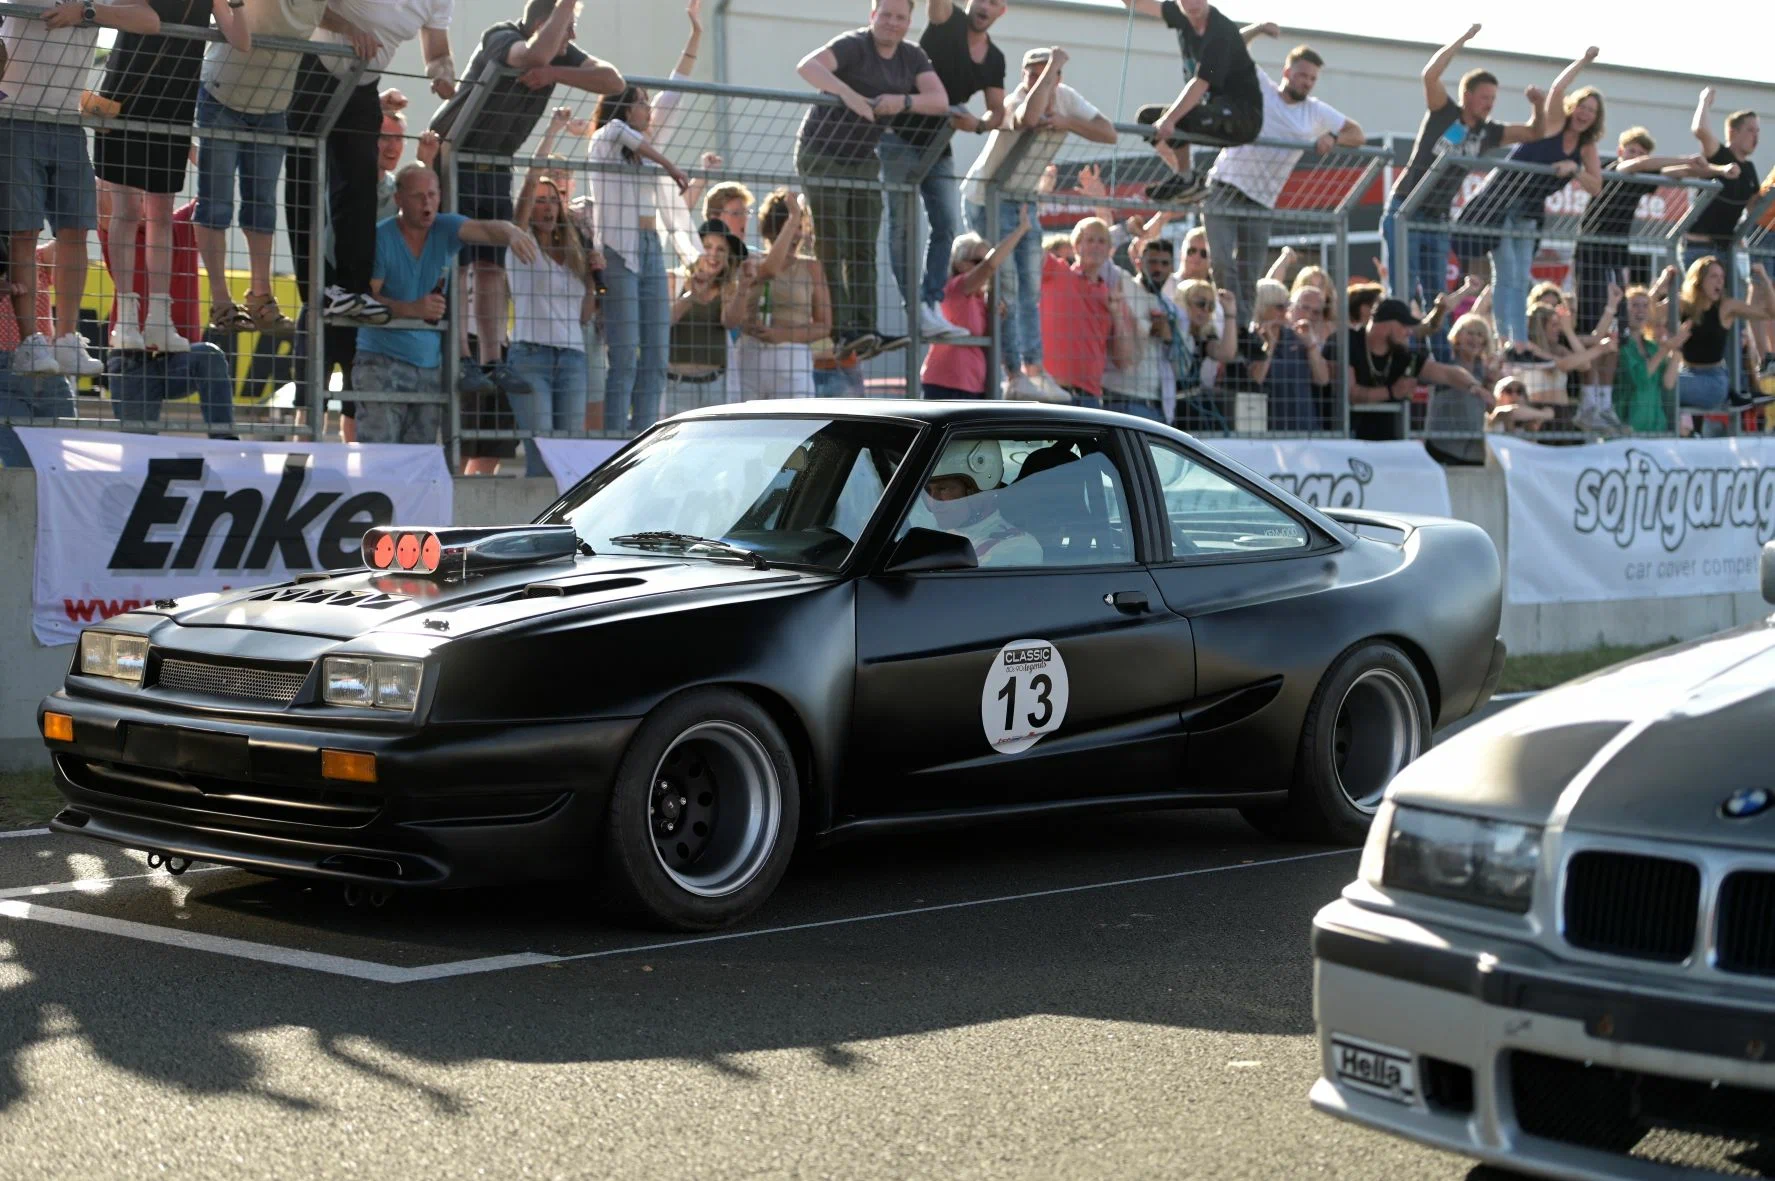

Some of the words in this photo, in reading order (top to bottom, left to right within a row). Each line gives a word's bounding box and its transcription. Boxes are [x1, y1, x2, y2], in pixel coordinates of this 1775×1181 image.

[107, 453, 394, 571] Enke
[1574, 449, 1775, 551] softgarag
[1624, 561, 1651, 580] car
[1656, 560, 1696, 578] cover
[1702, 552, 1758, 580] compet
[1005, 648, 1050, 663] CLASSIC
[998, 673, 1053, 731] 13
[1342, 1047, 1402, 1085] Hella
